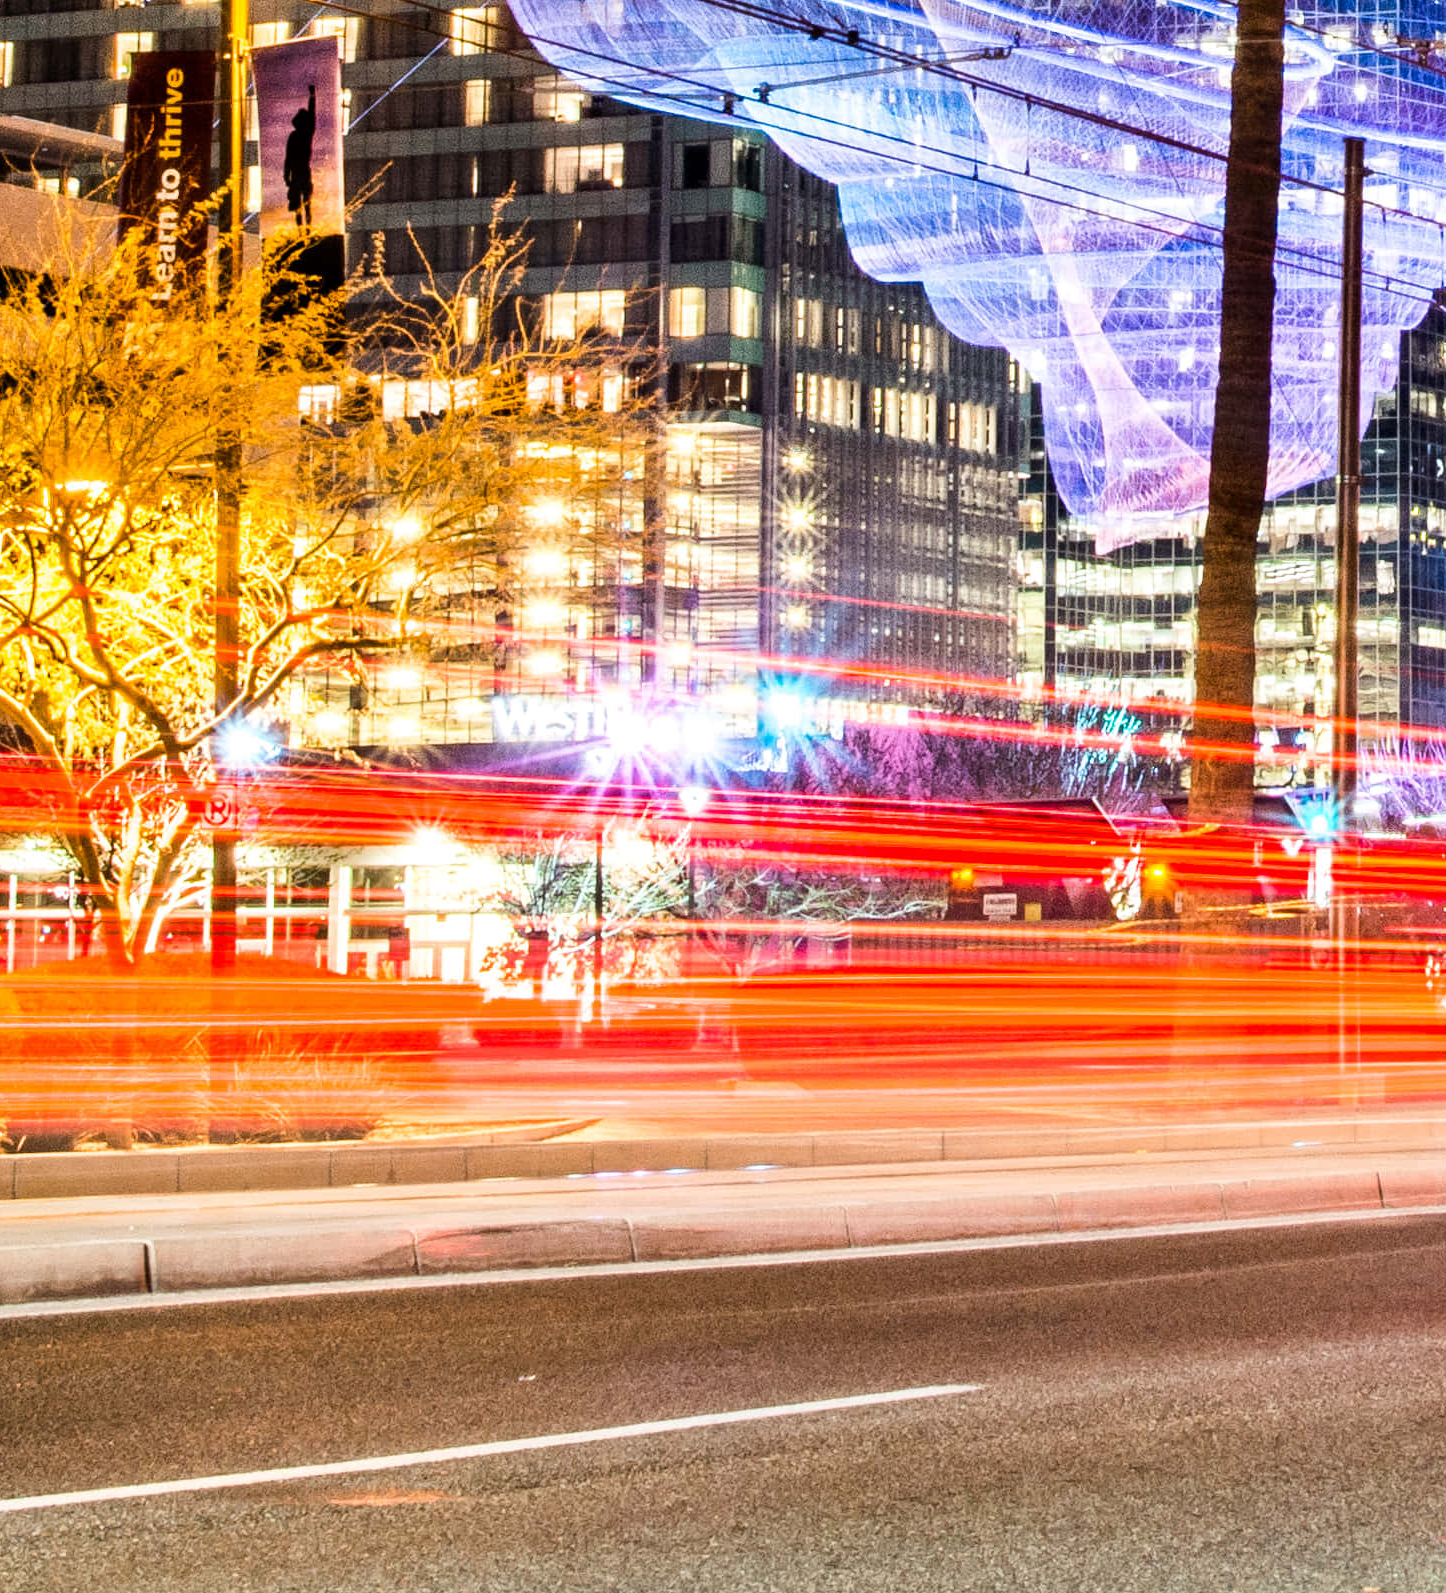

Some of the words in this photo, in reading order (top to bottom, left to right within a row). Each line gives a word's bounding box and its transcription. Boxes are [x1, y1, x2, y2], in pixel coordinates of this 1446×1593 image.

[158, 67, 185, 160] thrive
[156, 168, 181, 203] to
[151, 209, 179, 302] Learn
